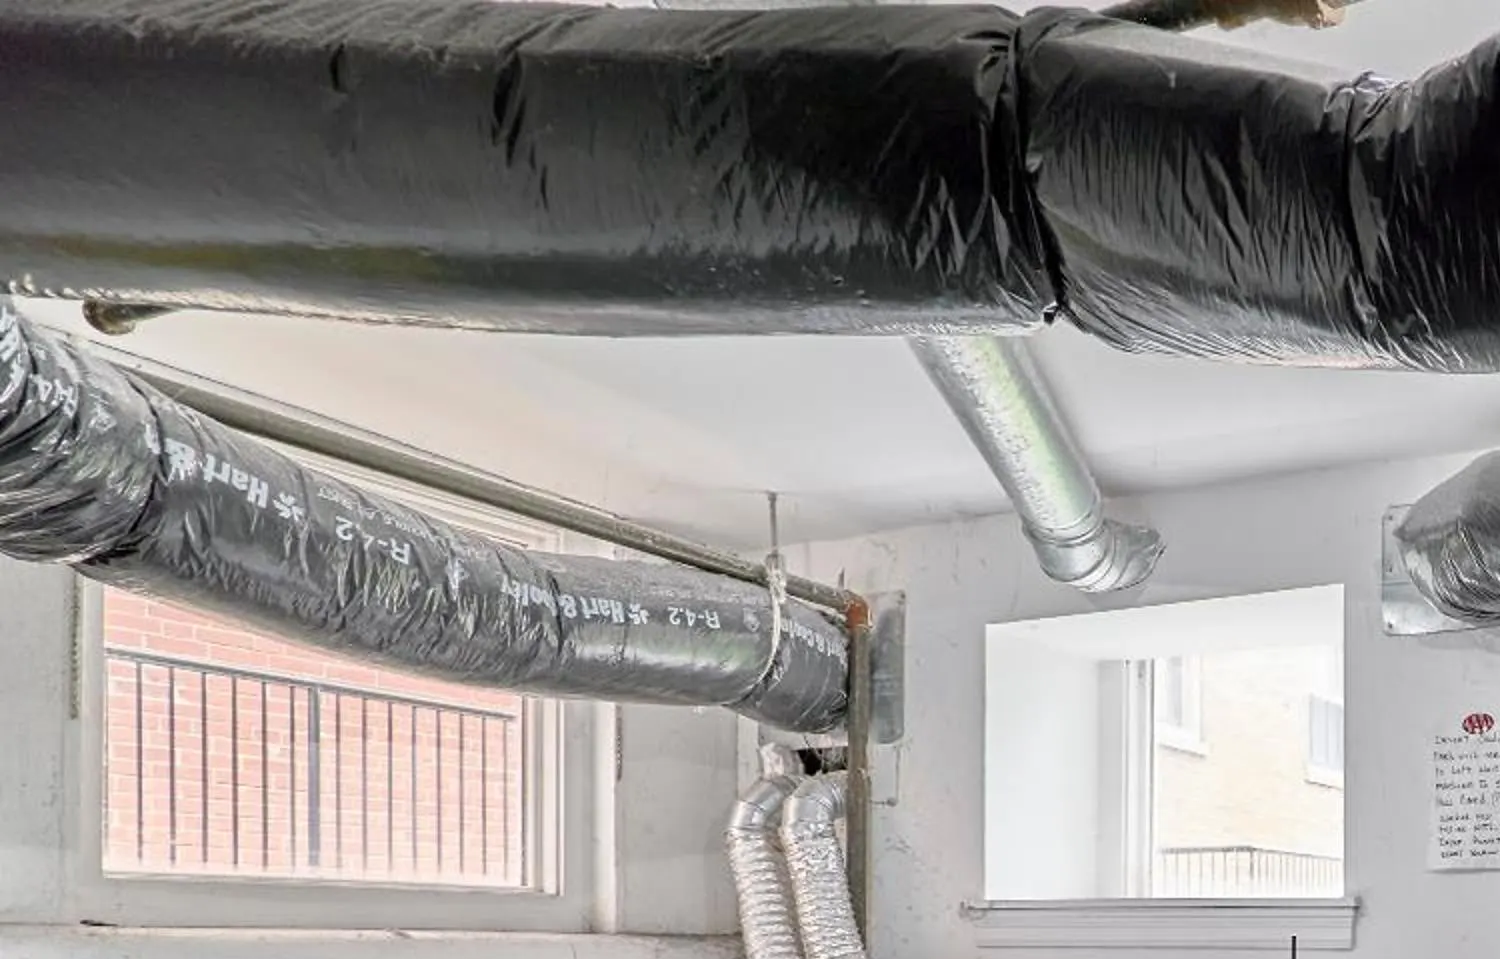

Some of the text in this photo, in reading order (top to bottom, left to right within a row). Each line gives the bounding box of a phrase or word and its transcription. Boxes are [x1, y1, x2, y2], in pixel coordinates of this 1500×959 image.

[202, 453, 268, 508] Hart
[580, 596, 625, 623] Hart
[667, 607, 720, 628] R-4.2
